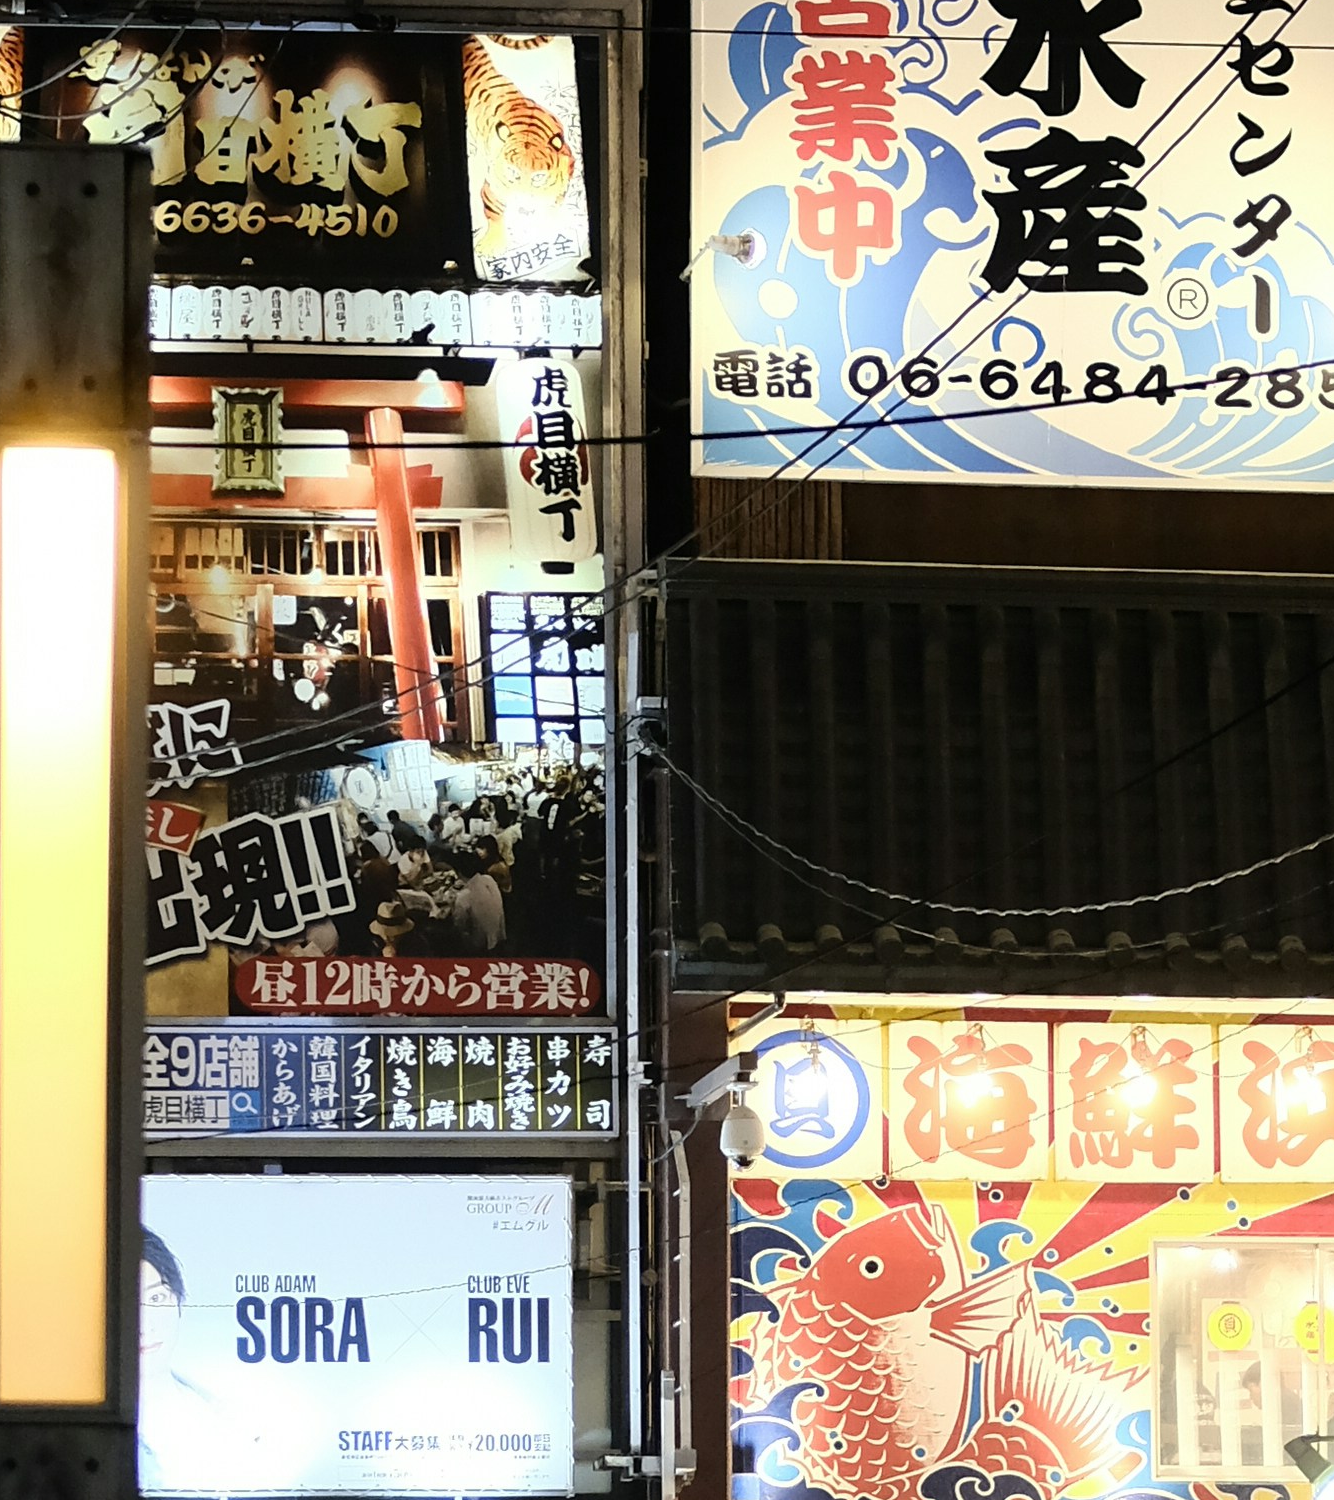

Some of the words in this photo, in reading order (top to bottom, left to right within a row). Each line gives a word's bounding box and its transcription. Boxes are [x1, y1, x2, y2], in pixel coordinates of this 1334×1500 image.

[153, 200, 399, 238] 6636-4510
[486, 233, 576, 280] 家内安全
[711, 350, 815, 402] 電話
[531, 365, 582, 543] 虎目横丁
[250, 960, 591, 1011] 昼12時から営業!
[143, 1035, 260, 1089] 全9店舗
[271, 1037, 301, 1128] からあげ
[307, 1035, 341, 1129] 韓国料理
[349, 1035, 377, 1129] イタリアン
[386, 1036, 418, 1130] 焼き鳥
[426, 1036, 458, 1130] 海鮮
[464, 1036, 496, 1130] 焼肉
[504, 1036, 536, 1130] お好み焼き
[545, 1035, 572, 1129] 串カツ
[583, 1034, 612, 1129] 寿司
[143, 1094, 229, 1124] 虎目横丁
[466, 1202, 512, 1214] GROUP
[235, 1274, 270, 1293] CLUB
[274, 1274, 317, 1293] ADAM
[467, 1275, 502, 1294] CLUB
[506, 1275, 530, 1294] EVE
[236, 1295, 371, 1364] SORA
[468, 1297, 551, 1364] RUI
